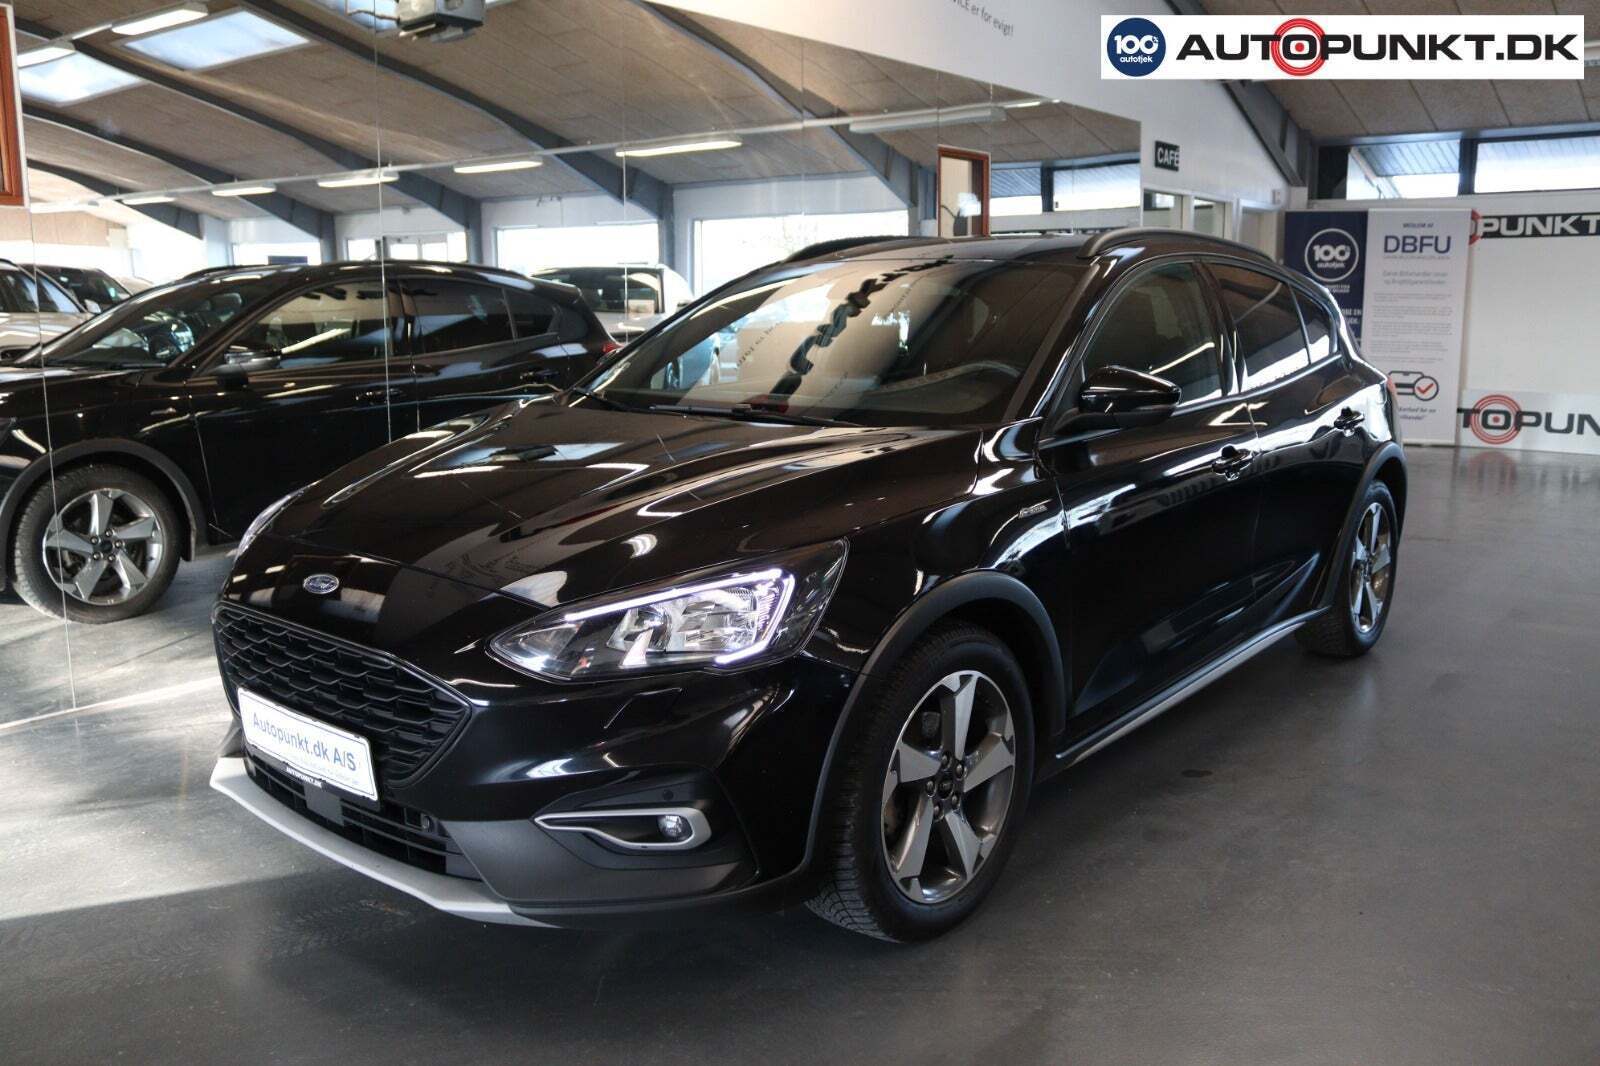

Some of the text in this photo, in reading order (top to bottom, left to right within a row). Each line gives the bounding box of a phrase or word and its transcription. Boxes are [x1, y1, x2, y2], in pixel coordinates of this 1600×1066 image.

[1384, 235, 1451, 254] DBFU
[253, 711, 356, 772] Autopunkt.dk A/S
